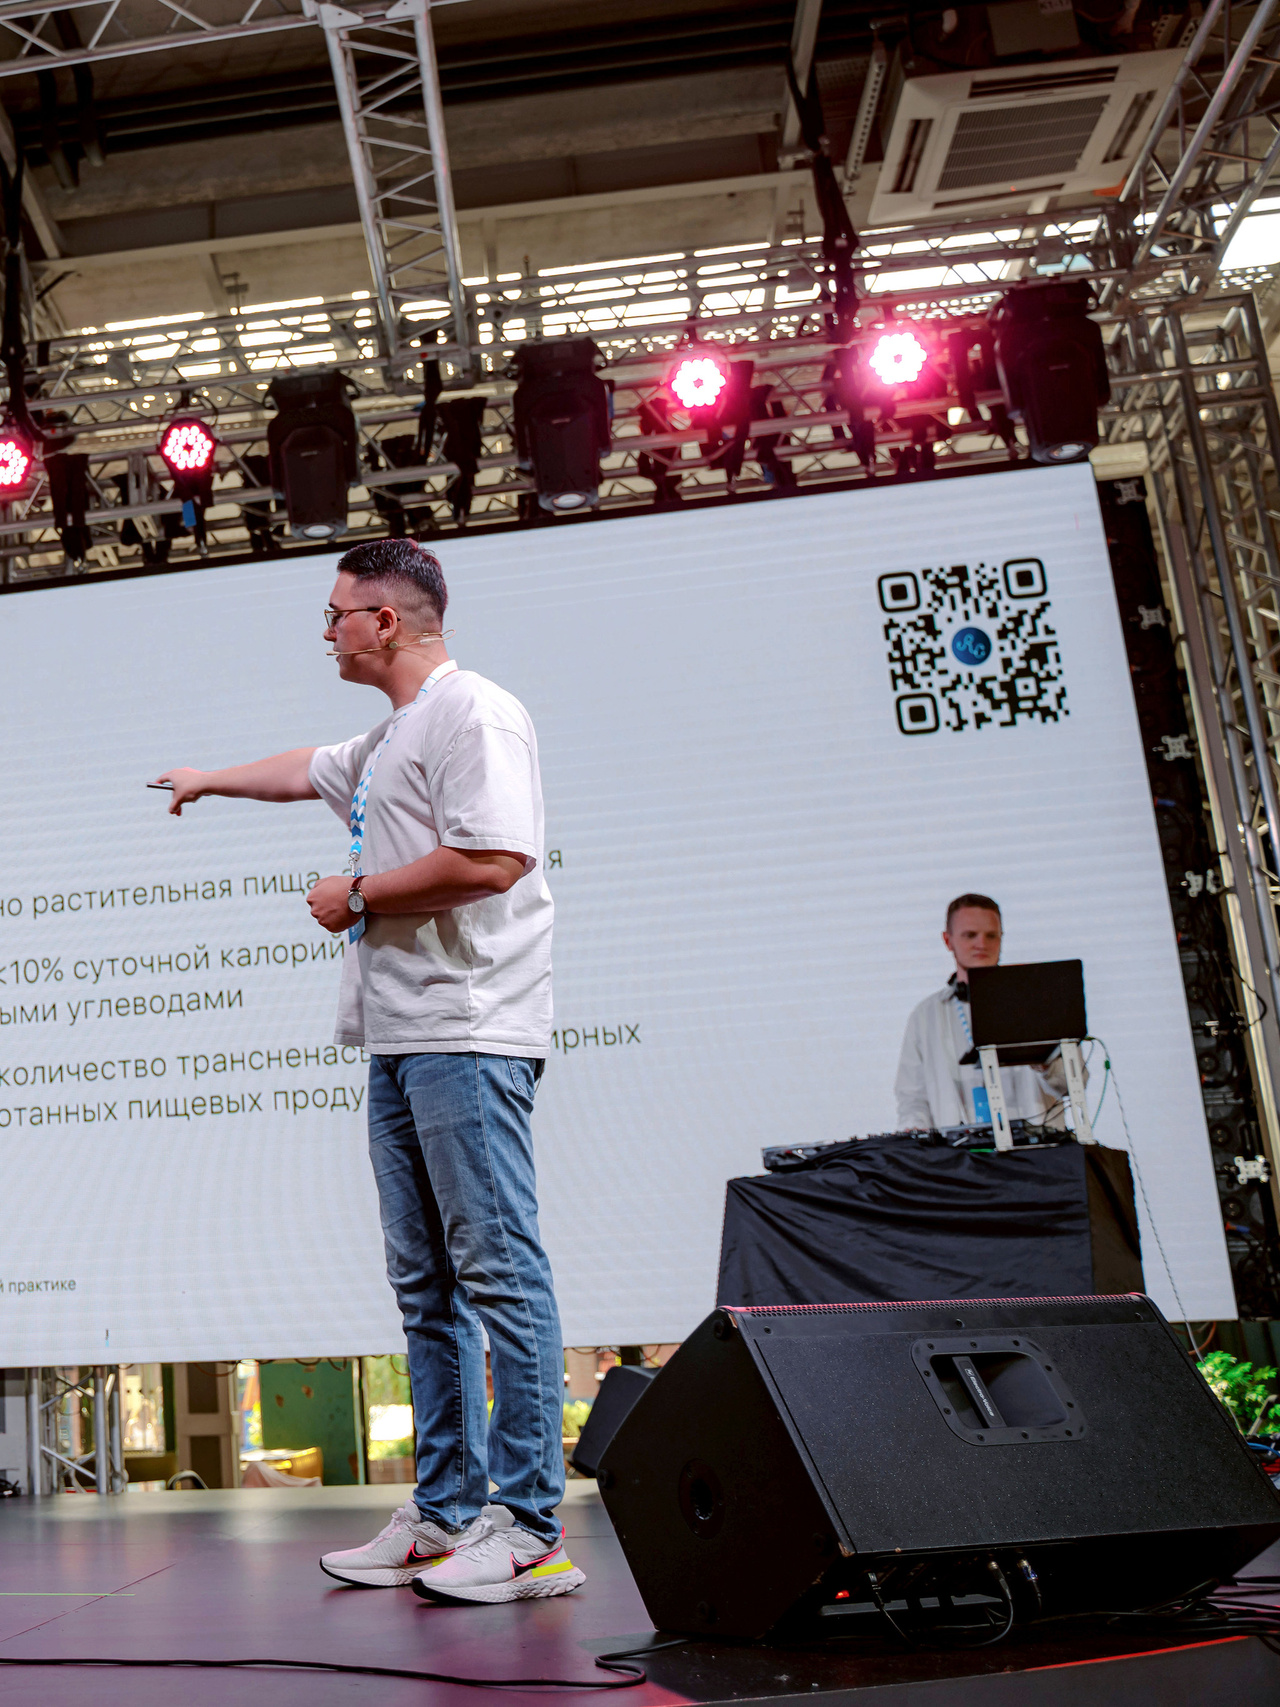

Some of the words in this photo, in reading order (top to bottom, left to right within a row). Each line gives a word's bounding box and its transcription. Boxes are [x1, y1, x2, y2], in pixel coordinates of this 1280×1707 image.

[33, 879, 232, 920] растительная
[74, 944, 209, 982] суточной
[67, 989, 243, 1026] углеводами
[551, 1023, 641, 1055] ирных
[129, 1093, 262, 1121] пищевых
[274, 1087, 363, 1115] проду
[9, 1280, 76, 1295] практике
